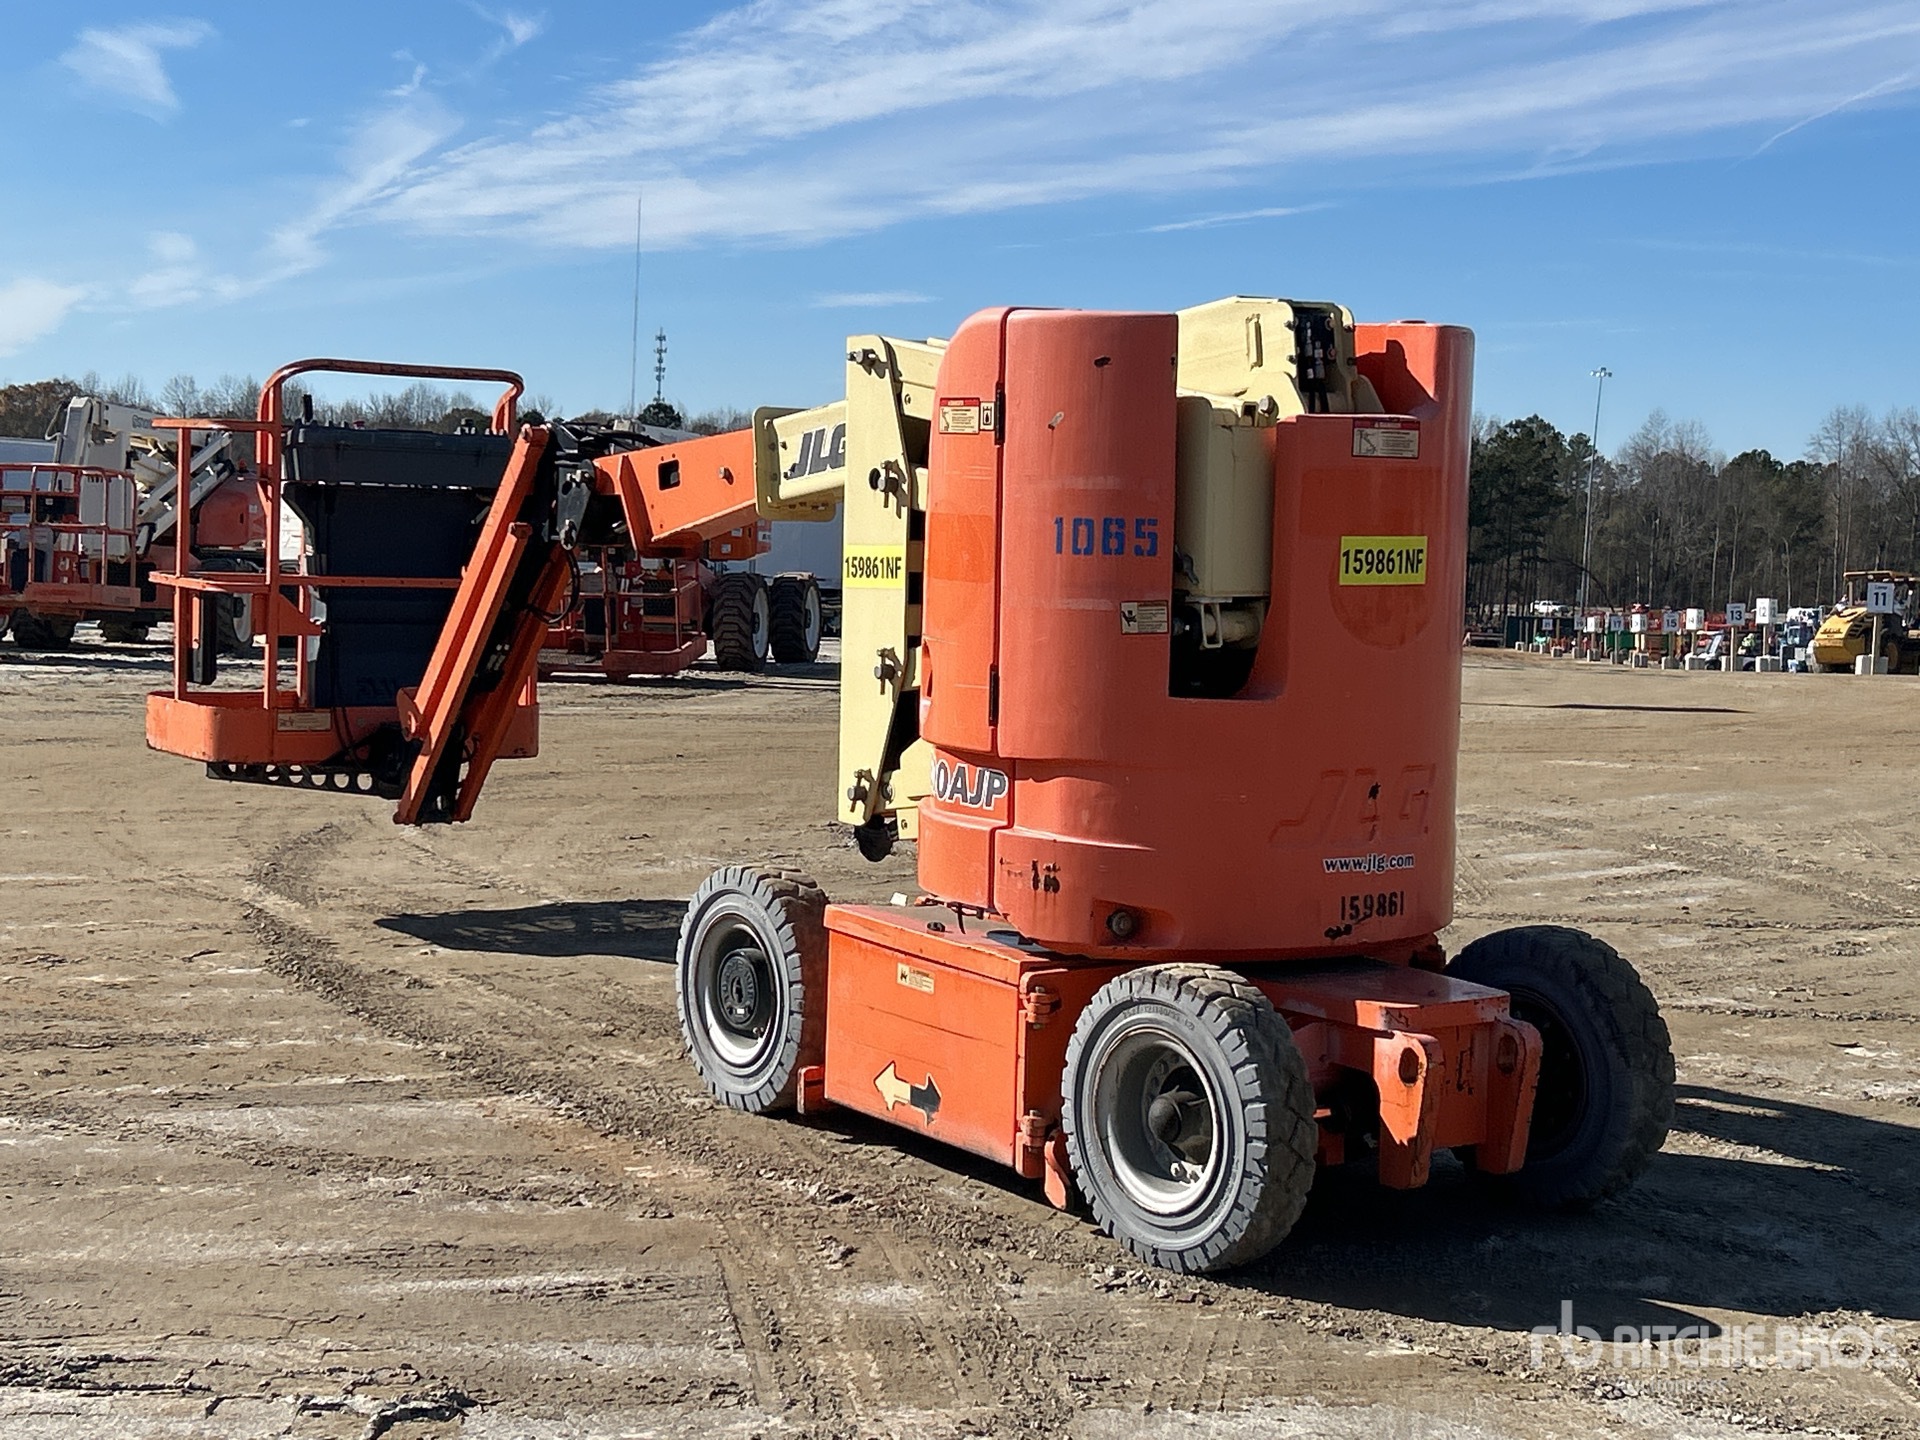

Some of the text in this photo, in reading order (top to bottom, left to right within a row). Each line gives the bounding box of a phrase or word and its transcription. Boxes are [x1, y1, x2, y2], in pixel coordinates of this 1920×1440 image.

[789, 423, 846, 480] JLG
[1054, 517, 1159, 558] 1065
[844, 556, 903, 580] 159861NF
[1341, 548, 1425, 576] 159861NF
[1873, 591, 1887, 607] 11
[1729, 610, 1743, 622] 13
[931, 759, 1009, 810] 0AJP
[1323, 853, 1415, 874] www.jlg.com
[1340, 890, 1405, 921] 159861
